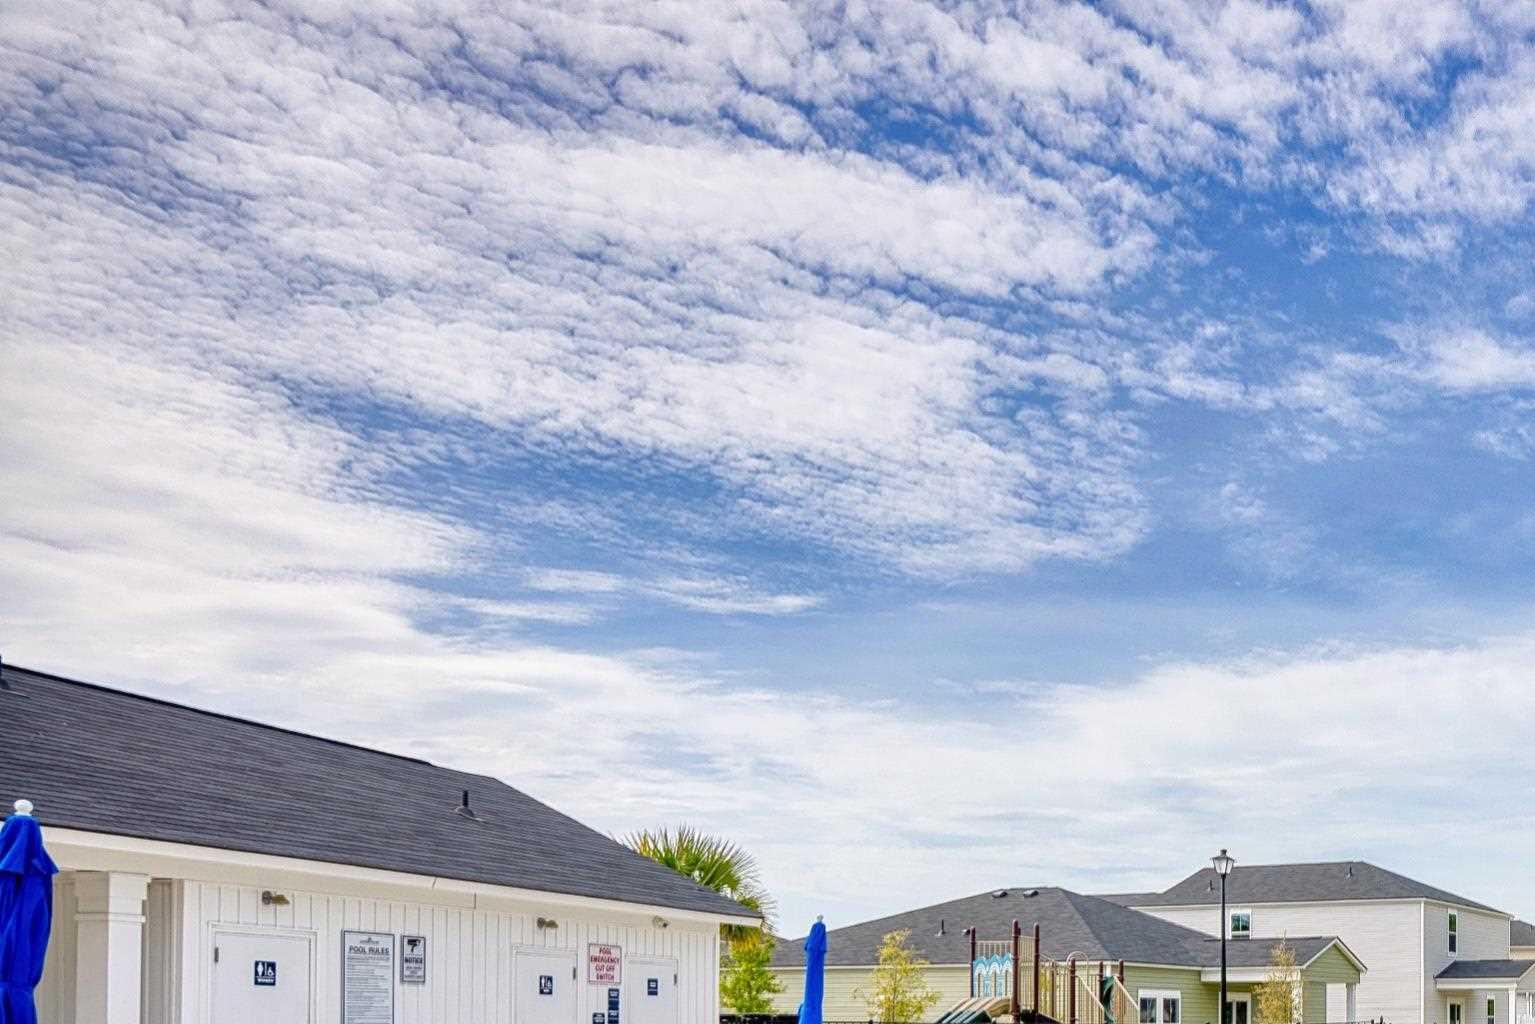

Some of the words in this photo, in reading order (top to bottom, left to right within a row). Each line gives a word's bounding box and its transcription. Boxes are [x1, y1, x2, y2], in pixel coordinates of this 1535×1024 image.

[349, 945, 366, 954] POOL
[369, 946, 390, 955] RULES
[591, 955, 619, 963] EMERGENCY
